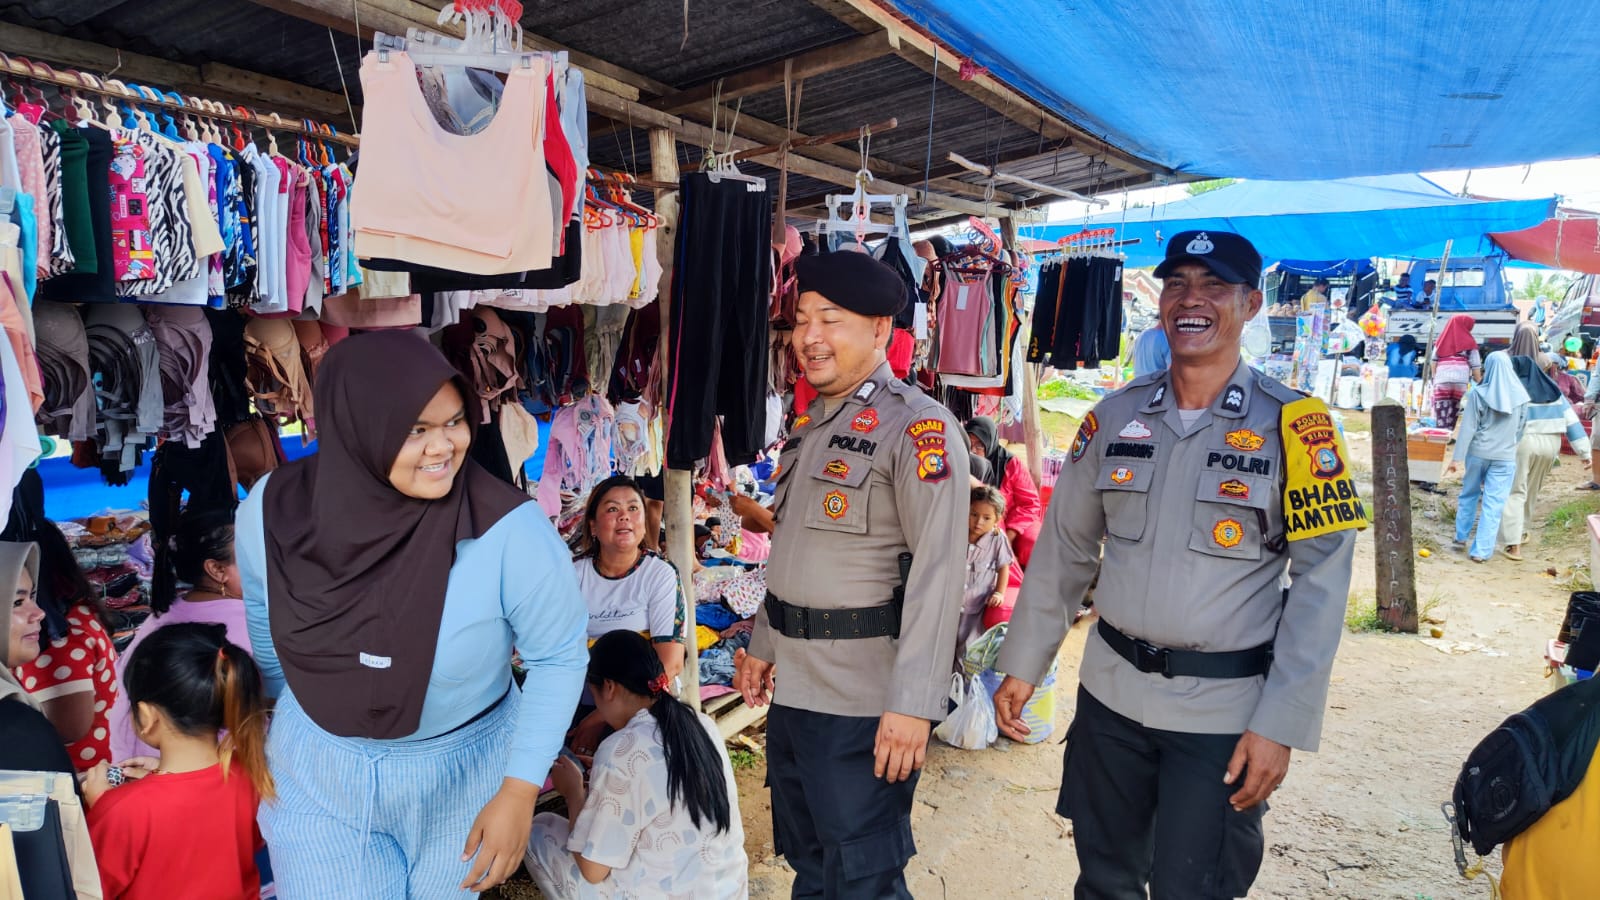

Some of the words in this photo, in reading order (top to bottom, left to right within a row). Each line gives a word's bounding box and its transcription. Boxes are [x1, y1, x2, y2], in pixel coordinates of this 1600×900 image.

[917, 438, 943, 447] RIAU
[1307, 431, 1329, 441] RIAU
[828, 434, 877, 456] POLRI
[1207, 452, 1270, 475] POLRI
